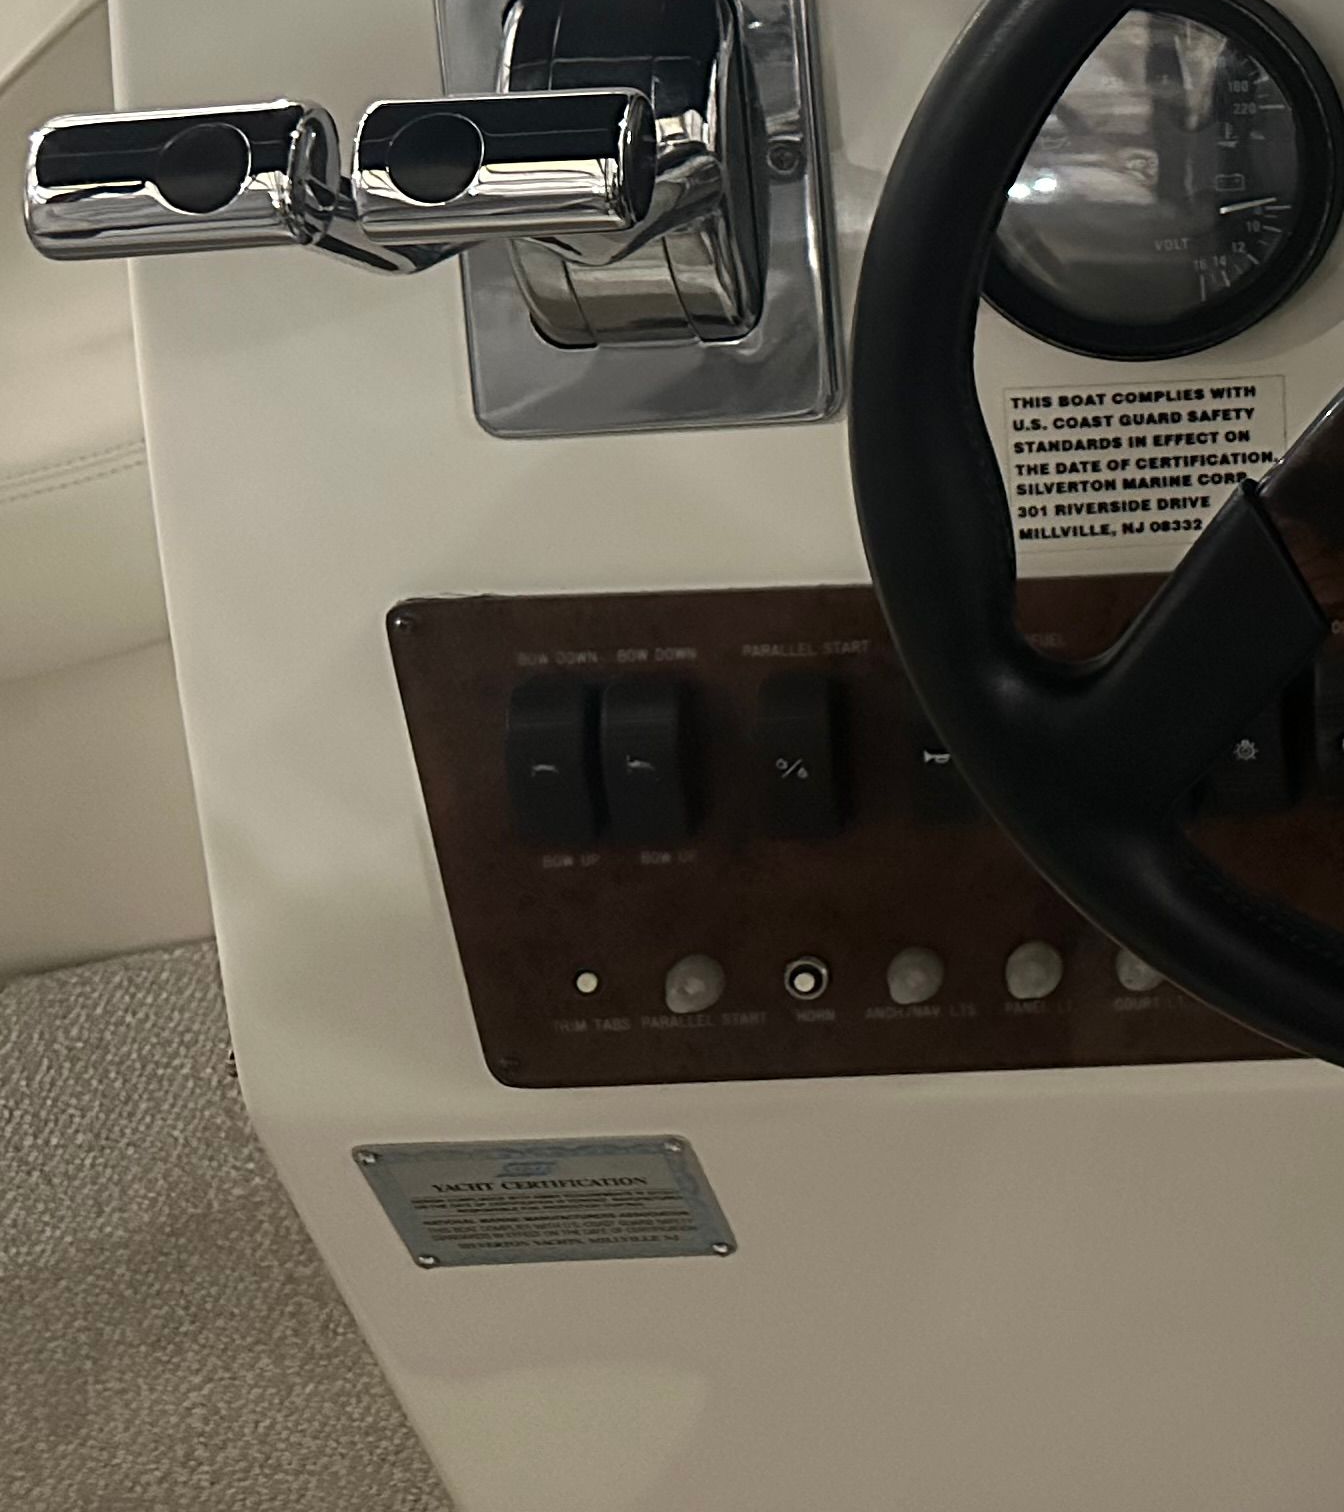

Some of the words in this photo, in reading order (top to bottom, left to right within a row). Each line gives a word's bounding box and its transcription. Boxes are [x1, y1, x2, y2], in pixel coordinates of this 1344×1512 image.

[1154, 238, 1191, 251] VOLT
[1011, 397, 1052, 409] THIS
[1059, 394, 1105, 408] BOAT
[1112, 389, 1205, 404] COMPLIES
[1210, 386, 1256, 399] WITH
[1013, 419, 1048, 431] U.S.
[1053, 416, 1113, 429] COAST
[1119, 412, 1183, 427] GUARD
[1187, 408, 1255, 423] SAFETY
[1015, 438, 1122, 454] STANDARDS
[1129, 435, 1147, 448] IN
[1153, 432, 1218, 447] EFFECT
[1225, 430, 1250, 443] ON
[1016, 463, 1049, 476] THE
[1056, 461, 1101, 474] DATE
[1107, 459, 1130, 472] OF
[1016, 479, 1117, 495] SILVERTON
[1123, 475, 1191, 491] MARINE
[1018, 506, 1048, 518] 301
[1055, 499, 1151, 516] RIVERSIDE
[1157, 496, 1210, 510] DRIVE
[1019, 524, 1117, 540] MILLVILLE,
[1122, 522, 1145, 536] NJ
[1150, 519, 1202, 533] 08332
[555, 650, 598, 665] DOWN
[617, 649, 649, 663] BOW
[655, 647, 697, 662] DOWN
[742, 643, 816, 659] PARALLEL
[823, 639, 872, 656] START
[432, 1181, 494, 1193] YACHT
[501, 1176, 648, 1191] CERTIFICATION
